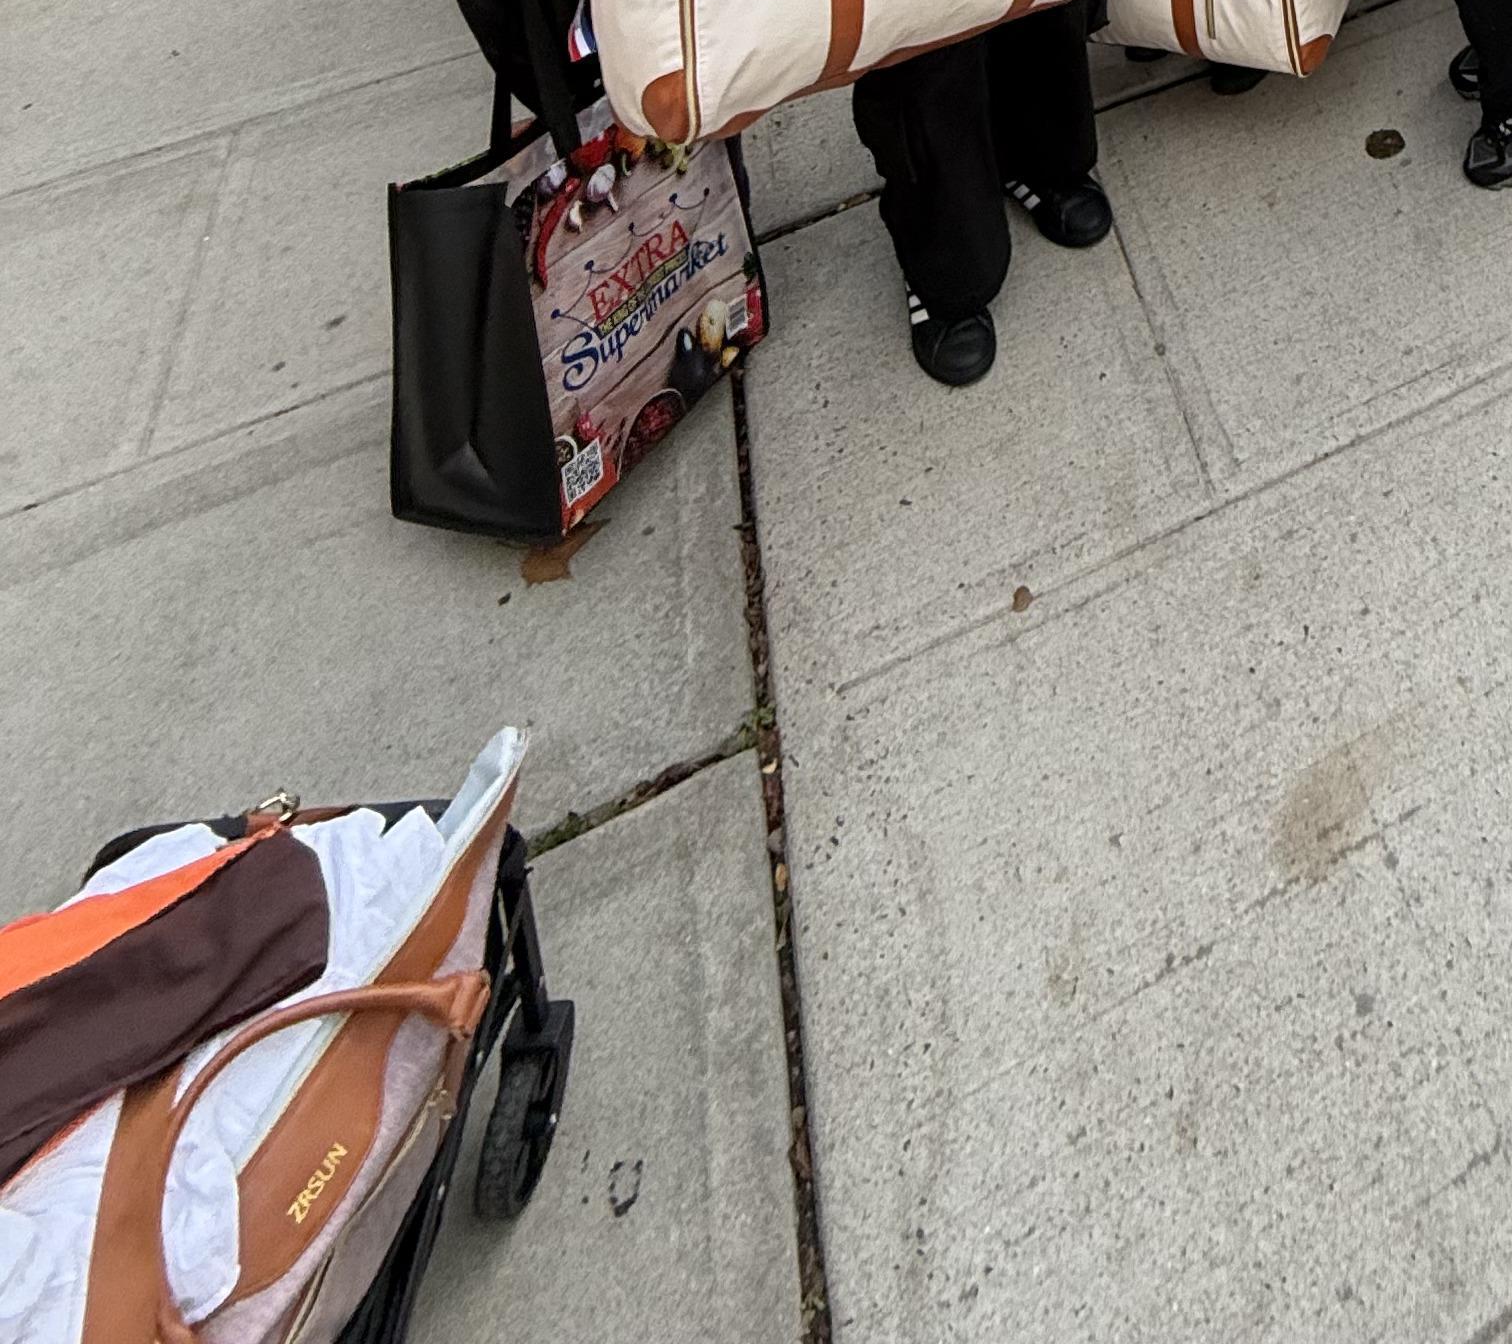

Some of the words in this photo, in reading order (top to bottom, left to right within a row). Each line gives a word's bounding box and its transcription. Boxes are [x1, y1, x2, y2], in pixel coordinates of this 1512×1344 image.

[561, 231, 730, 392] Supermarket
[586, 219, 690, 322] EXTRA
[285, 1140, 349, 1225] ZRSUN
